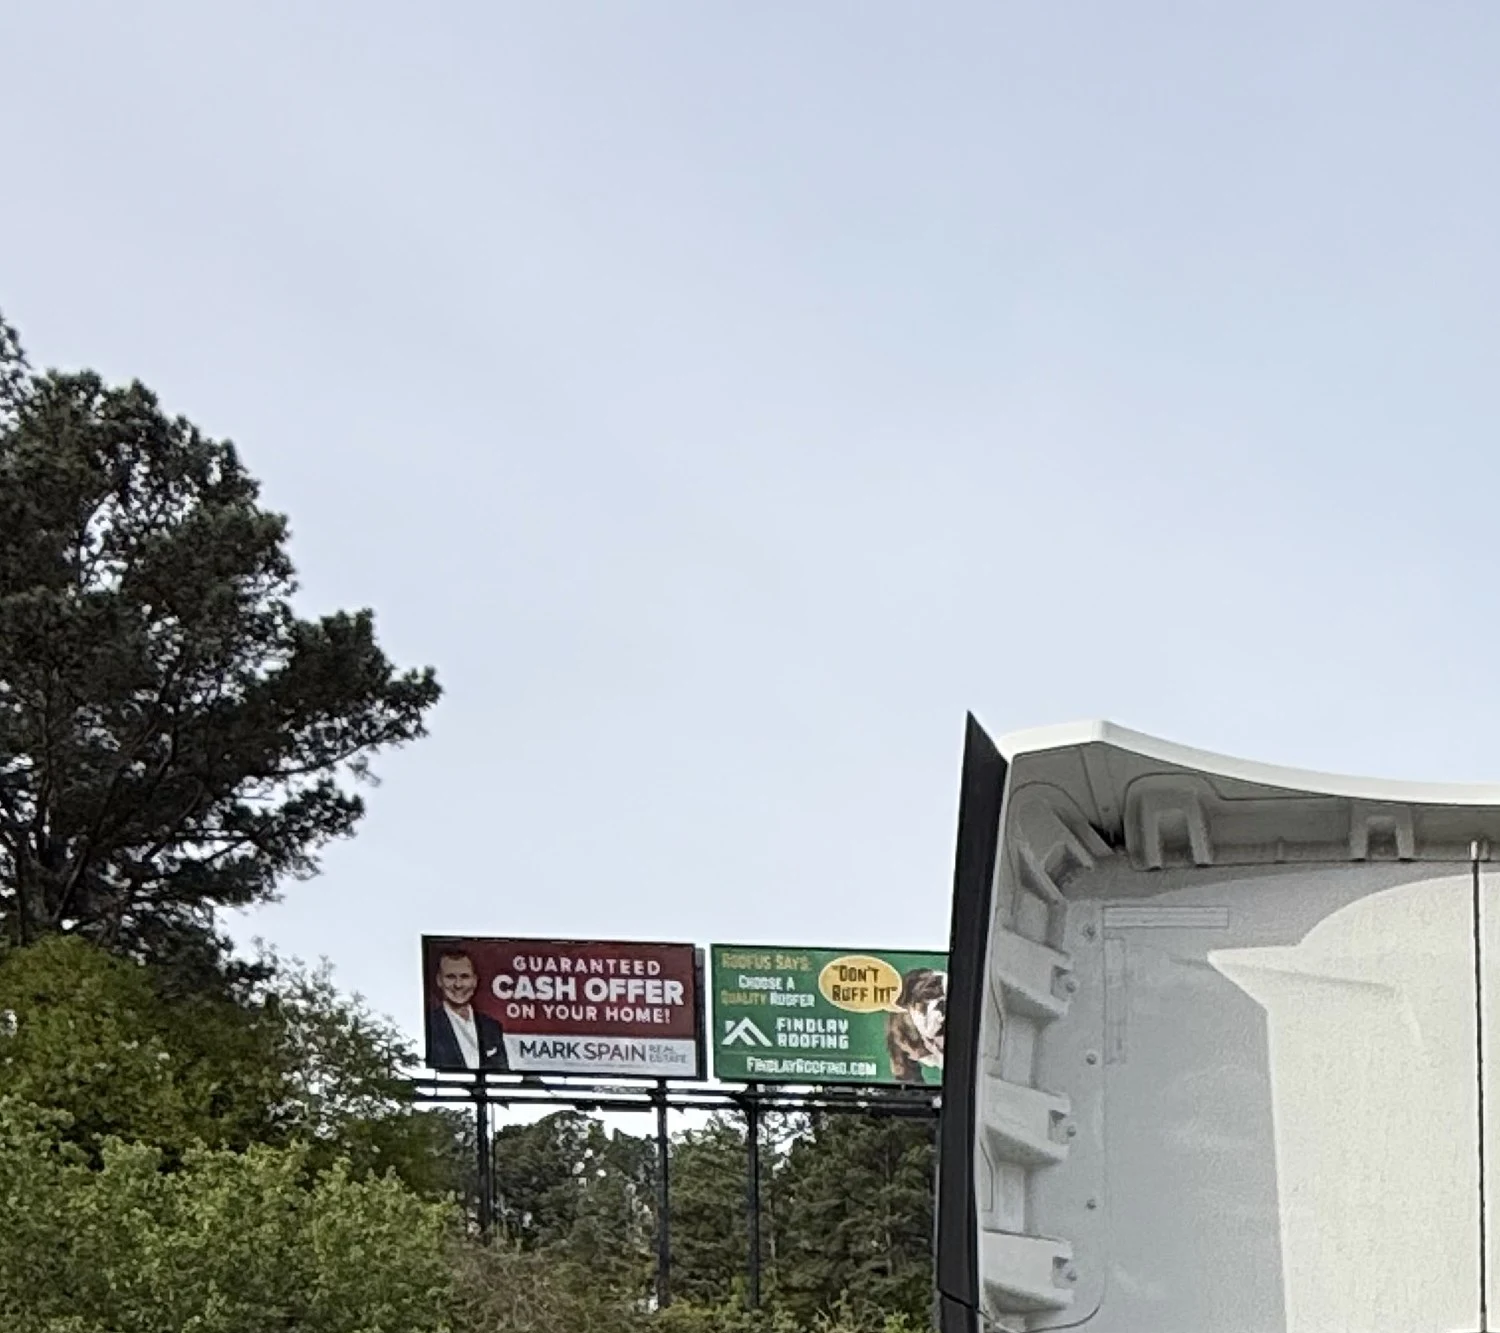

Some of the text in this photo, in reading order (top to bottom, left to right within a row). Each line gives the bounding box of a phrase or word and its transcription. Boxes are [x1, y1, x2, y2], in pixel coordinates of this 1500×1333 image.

[513, 955, 661, 975] GUARANTEED
[492, 975, 684, 1005] CASH OFFER
[786, 976, 796, 992] A
[832, 985, 868, 1003] RUFF
[506, 1003, 671, 1024] ON YOUR HOME!
[776, 1017, 849, 1034] FINDLAY
[777, 1033, 849, 1050] ROOFING
[519, 1040, 647, 1063] MARK SPAIN
